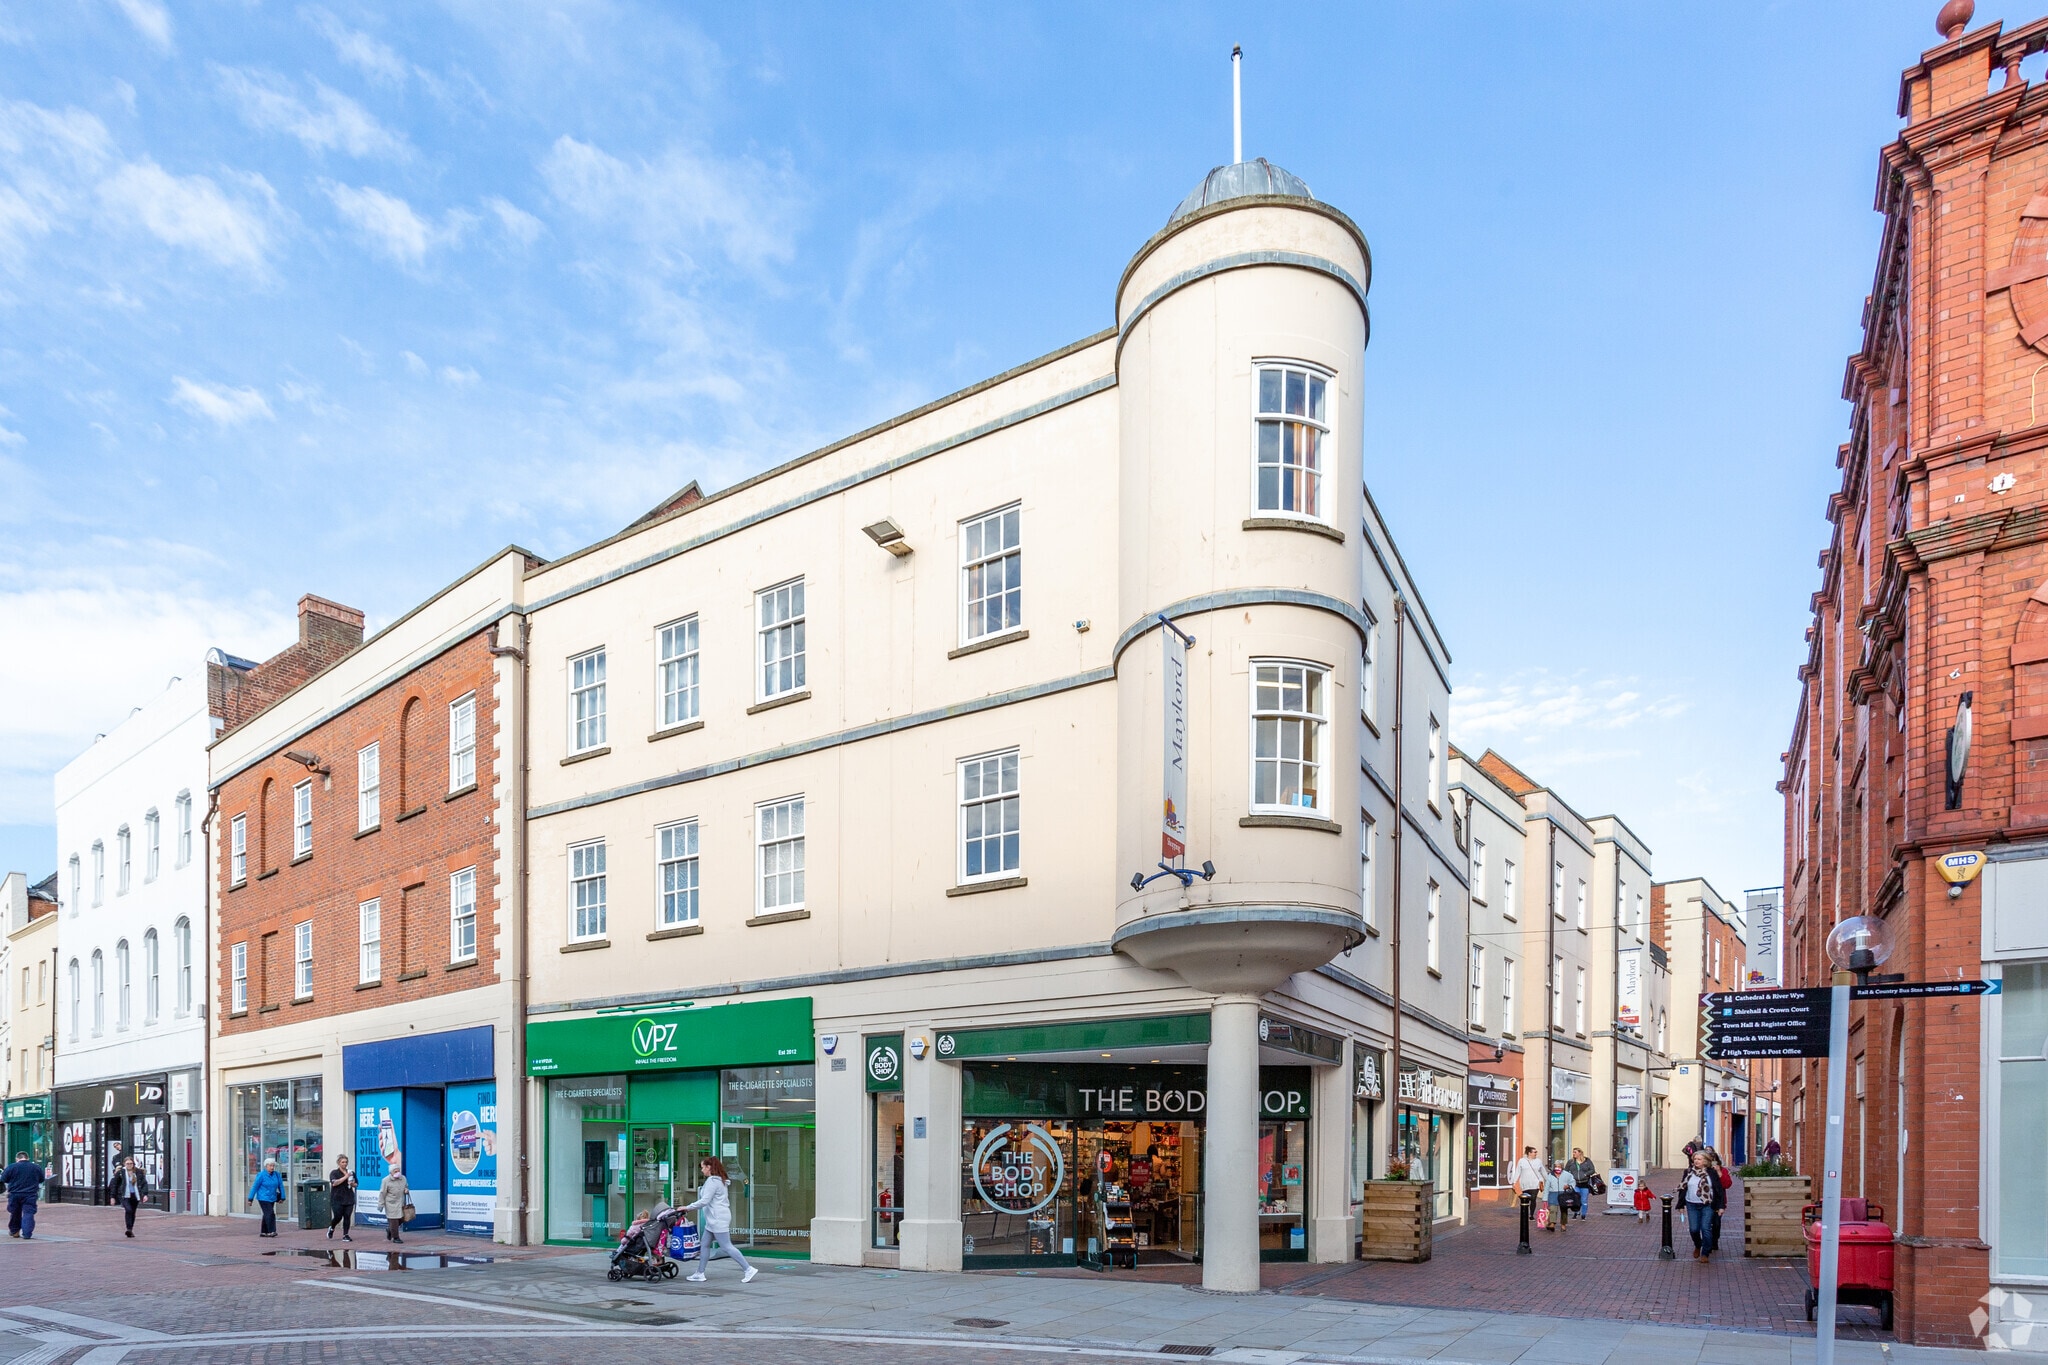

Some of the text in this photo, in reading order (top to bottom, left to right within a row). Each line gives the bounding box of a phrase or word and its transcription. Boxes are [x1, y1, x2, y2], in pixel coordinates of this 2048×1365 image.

[1948, 855, 1976, 866] MHS
[1757, 903, 1776, 956] Maylord
[1626, 959, 1639, 995] Maylord
[637, 1023, 678, 1052] VPZ
[729, 1078, 813, 1091] THE E-CIGARETTE SPECIALISTS
[139, 1086, 162, 1100] JD
[477, 1091, 491, 1105] FIND
[555, 1087, 622, 1098] THE E-CIGARETTE SPECIALISTS
[1483, 1090, 1508, 1102] POWERHOUSE
[102, 1090, 114, 1113] JD
[272, 1095, 291, 1110] iStor
[1078, 1089, 1301, 1113] THE BOD OP
[360, 1137, 379, 1156] STILL
[1002, 1151, 1034, 1164] THE
[360, 1156, 381, 1177] HERE
[991, 1166, 1047, 1181] BODY
[994, 1183, 1045, 1197] SHOP
[788, 1229, 797, 1237] CAN
